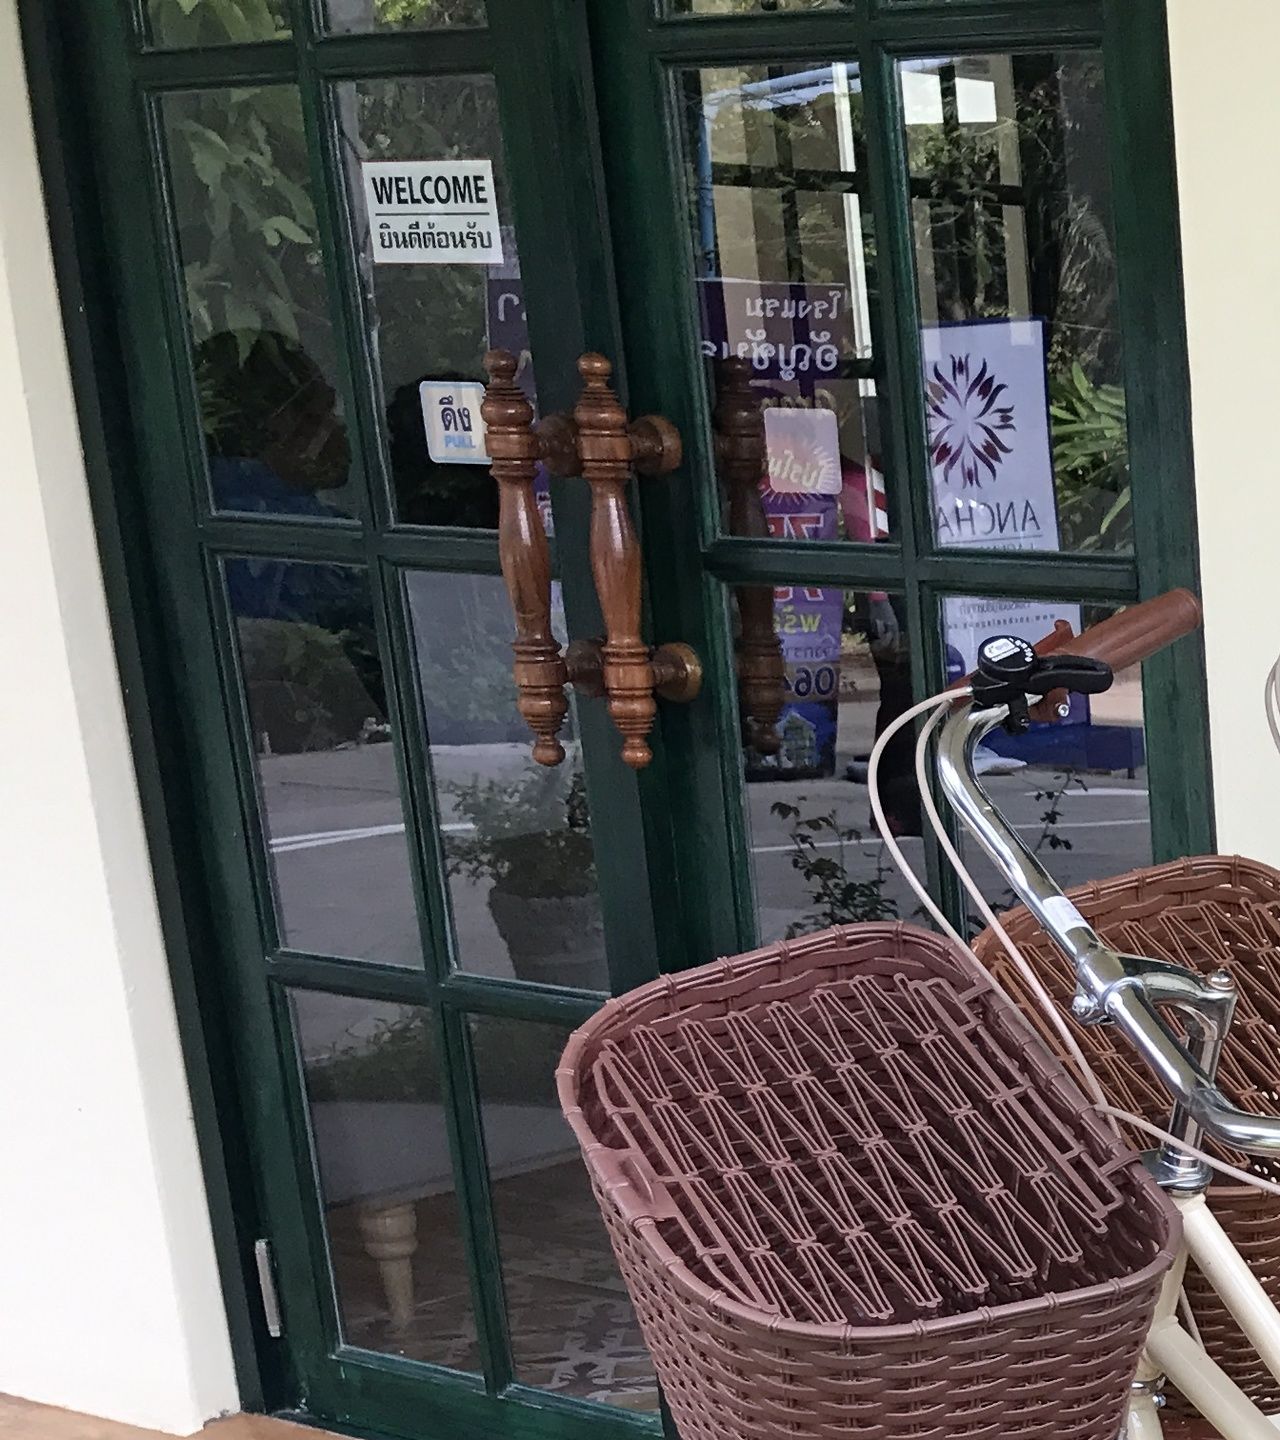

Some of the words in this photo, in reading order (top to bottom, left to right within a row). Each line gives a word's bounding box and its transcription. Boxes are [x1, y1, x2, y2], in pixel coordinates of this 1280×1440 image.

[371, 175, 488, 205] WELCOME
[378, 220, 493, 249] ยินดีต้อนรับ
[438, 395, 473, 432] ดึง
[444, 434, 476, 448] PULL
